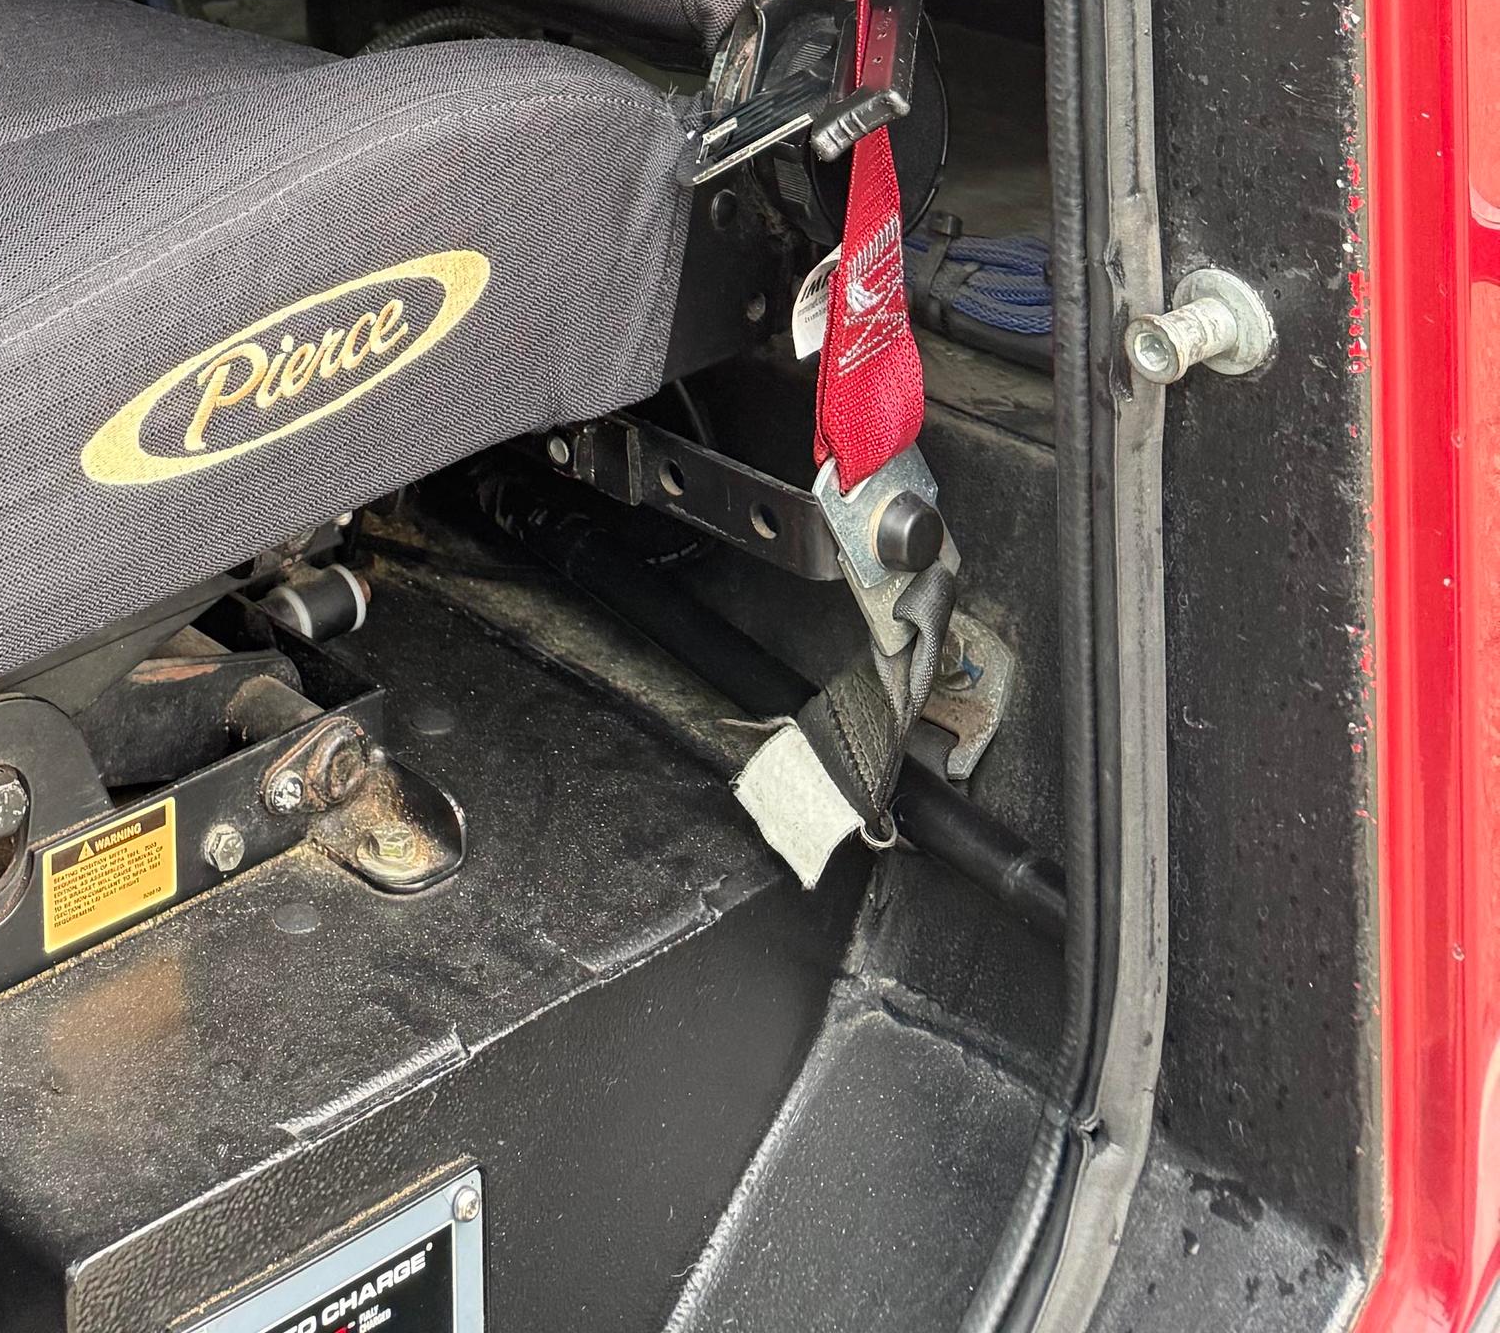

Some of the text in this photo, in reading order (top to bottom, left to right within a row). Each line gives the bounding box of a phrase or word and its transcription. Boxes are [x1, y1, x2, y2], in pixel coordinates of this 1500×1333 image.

[184, 298, 409, 451] Pierce
[95, 823, 141, 851] WARNING
[54, 847, 128, 884] SEATING POSITION MEETS
[128, 851, 153, 866] REMOVAL
[53, 868, 98, 892] REQUIREMENTS
[70, 883, 96, 899] BRACKET
[98, 876, 112, 886] WILL
[113, 867, 131, 880] CAUSE
[134, 861, 145, 870] THE
[147, 854, 161, 864] SEAT
[103, 888, 117, 899] SEAT
[119, 878, 140, 892] HEIGHT
[74, 879, 121, 904] NON-COMPLIANT
[322, 1251, 426, 1326] CHARGE
[359, 1304, 379, 1324] FULLY
